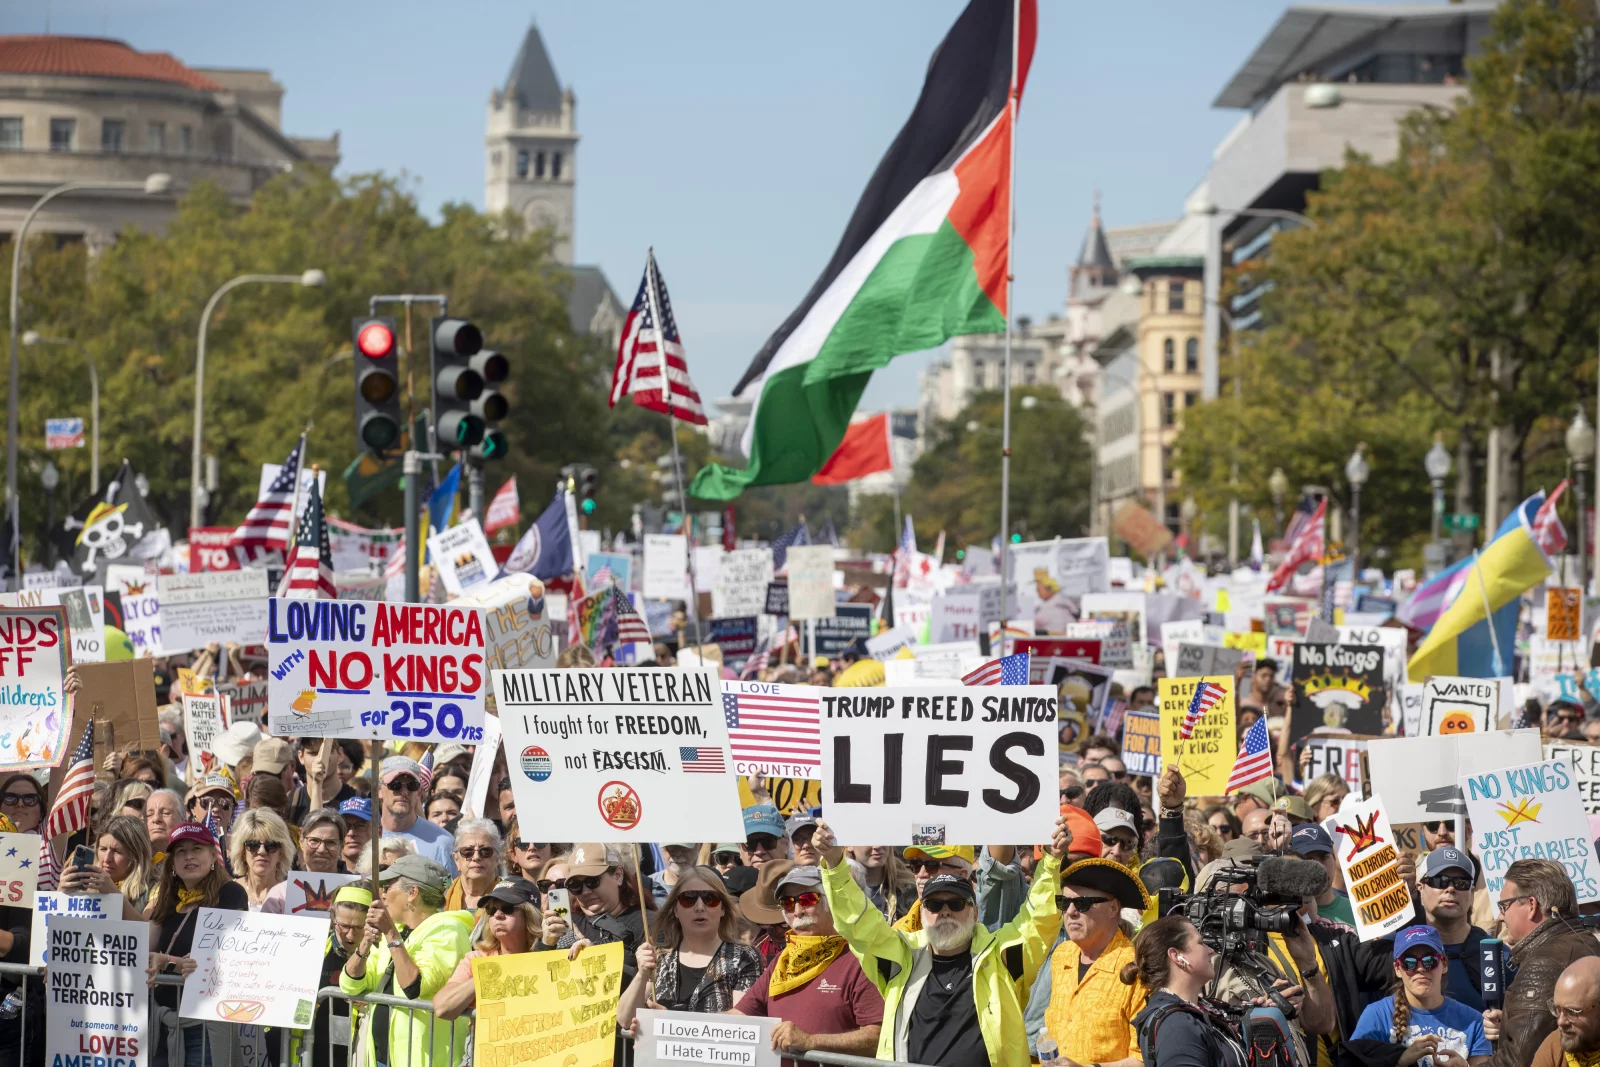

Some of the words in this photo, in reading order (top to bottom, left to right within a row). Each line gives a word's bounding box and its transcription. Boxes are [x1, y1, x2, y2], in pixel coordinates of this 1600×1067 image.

[190, 531, 232, 545] POWE
[197, 548, 230, 567] TO
[194, 626, 236, 636] TYRANNY
[269, 598, 366, 643] LOVING
[372, 603, 484, 648] AMERICA
[76, 638, 100, 652] NO
[1349, 630, 1380, 644] NO
[1180, 646, 1204, 660] NO
[1300, 646, 1324, 665] No
[1325, 644, 1380, 674] Kings
[270, 649, 305, 680] WITH
[308, 650, 374, 690] NO
[383, 654, 484, 694] KINGS
[502, 672, 604, 702] MILITARY
[612, 672, 712, 702] VETERAN
[725, 682, 729, 692] I
[740, 682, 780, 695] LOVE
[1432, 683, 1492, 698] WANTED
[191, 701, 216, 711] PEOPLE
[822, 696, 894, 718] TRUMP
[902, 696, 974, 722] FREED
[982, 696, 1057, 722] SANTOS
[280, 721, 328, 732] DEMOCRACY
[390, 700, 464, 738] 250
[461, 726, 484, 741] YRS
[523, 715, 530, 735] I
[534, 714, 582, 740] fought
[588, 714, 609, 734] for
[615, 715, 708, 739] FREEDOM,
[194, 731, 215, 742] TRUT
[194, 740, 212, 750] MATTE
[1124, 733, 1146, 753] FOR
[1146, 736, 1161, 756] AL
[1174, 744, 1184, 756] NO
[1190, 740, 1219, 755] KINGS
[564, 752, 588, 770] not
[593, 750, 672, 771] FASCISM.
[737, 762, 812, 777] COUNTRY
[1124, 752, 1146, 772] NOT
[1146, 755, 1155, 774] A
[834, 732, 1044, 814] LIES
[1468, 773, 1502, 800] NO
[1506, 762, 1570, 798] KINGS
[921, 826, 937, 835] LIES
[1479, 827, 1521, 850] JUST
[1349, 866, 1364, 882] NO
[1362, 846, 1397, 872] THRONES
[1354, 884, 1371, 902] NO
[1370, 867, 1401, 894] CROWN
[38, 896, 58, 912] I'M
[68, 898, 102, 912] HERE
[1360, 902, 1381, 924] NO
[1383, 886, 1410, 916] KINGS
[204, 912, 227, 931] We
[256, 928, 287, 942] people
[292, 932, 314, 947] say
[52, 930, 82, 947] NOT
[84, 932, 96, 948] A
[103, 934, 138, 951] PAID
[198, 933, 280, 956] ENOUGH!!
[52, 947, 137, 968] PROTESTER
[214, 952, 227, 964] No
[230, 958, 272, 970] corruption
[52, 972, 81, 990] NOT
[84, 974, 96, 990] A
[208, 966, 224, 976] No
[228, 970, 258, 981] cruelty
[477, 962, 538, 1000] BACK
[546, 958, 570, 982] TO
[581, 954, 607, 976] THE
[205, 986, 219, 998] No
[226, 990, 276, 1002] lawlessness
[208, 976, 223, 986] No
[244, 980, 260, 990] cuts
[265, 980, 276, 990] for
[278, 984, 316, 995] billionaires
[556, 972, 600, 1000] DAYS
[602, 971, 620, 996] OF
[52, 988, 134, 1008] TERRORIST
[70, 1018, 84, 1029] but
[84, 1020, 119, 1032] someone
[122, 1023, 138, 1033] who
[480, 1002, 564, 1043] TAXATION
[661, 1022, 664, 1034] I
[669, 1023, 699, 1037] Love
[701, 1024, 756, 1040] America
[78, 1034, 139, 1058] LOVES
[478, 1022, 598, 1067] REPRESENTATION
[664, 1044, 668, 1056] I
[672, 1044, 703, 1058] Hate
[708, 1048, 750, 1064] Trump
